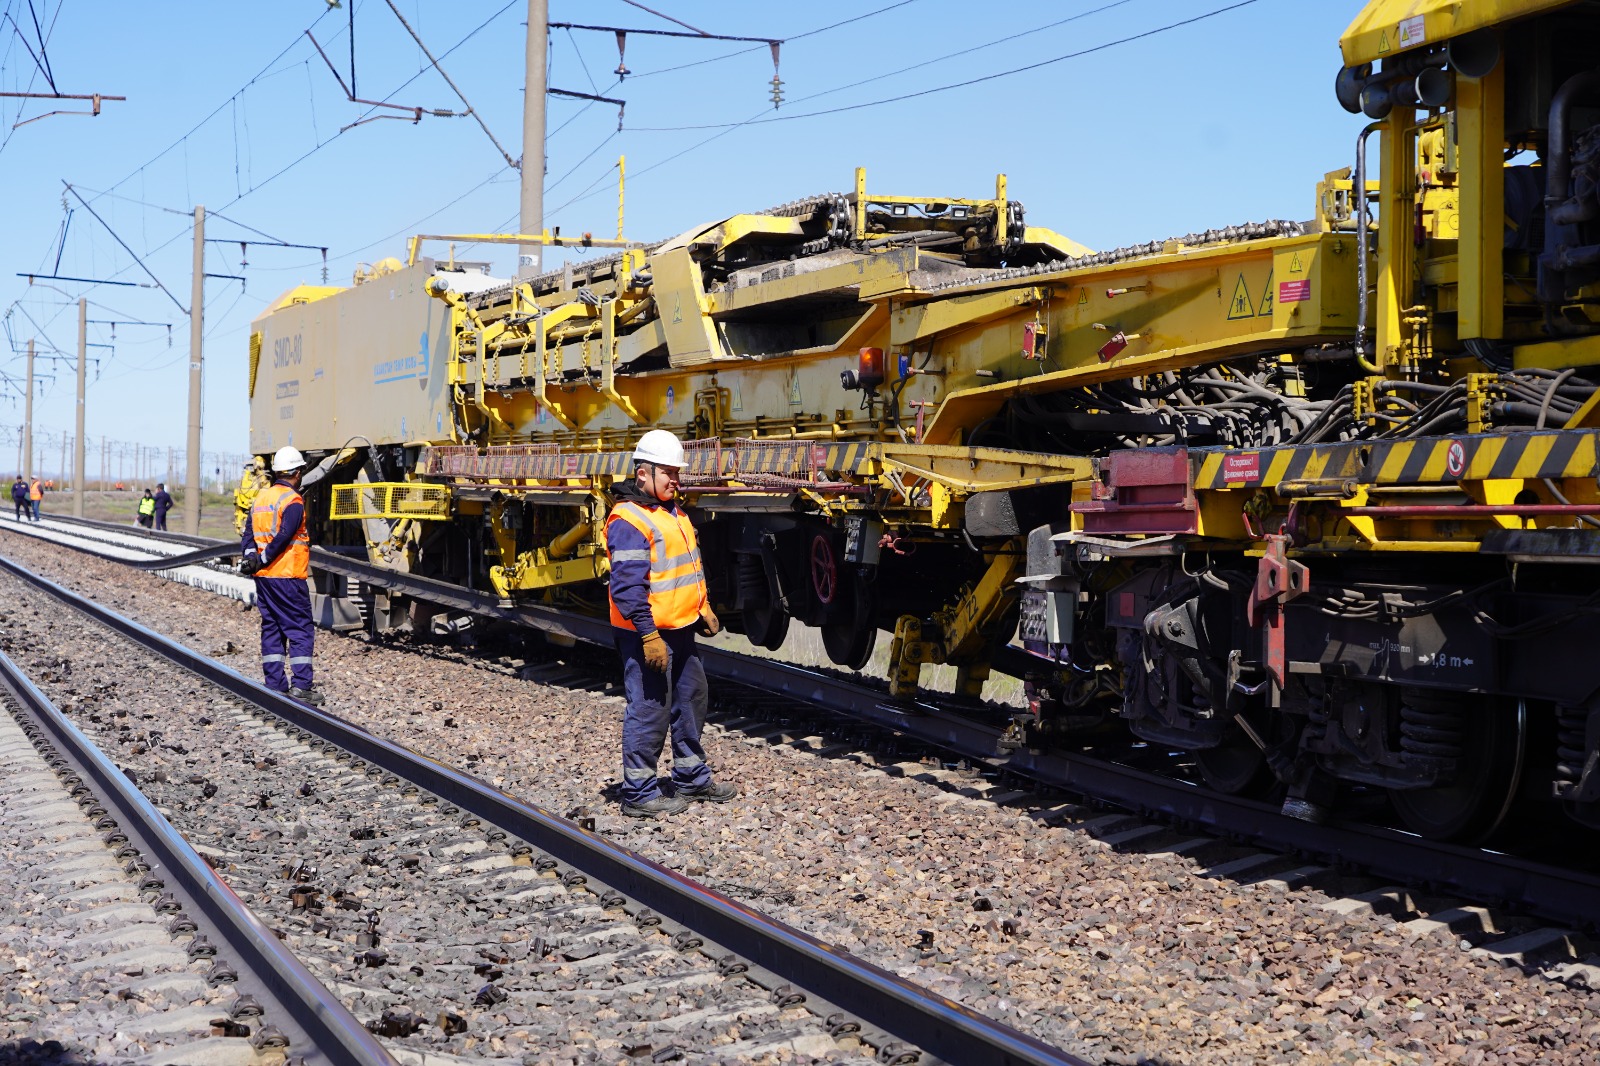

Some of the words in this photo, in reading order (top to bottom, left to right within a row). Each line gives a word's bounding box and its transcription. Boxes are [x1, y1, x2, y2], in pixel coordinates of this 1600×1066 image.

[274, 334, 302, 368] SMD-80
[966, 594, 979, 621] Z2
[1430, 652, 1446, 668] 1,8
[1450, 656, 1462, 667] m
